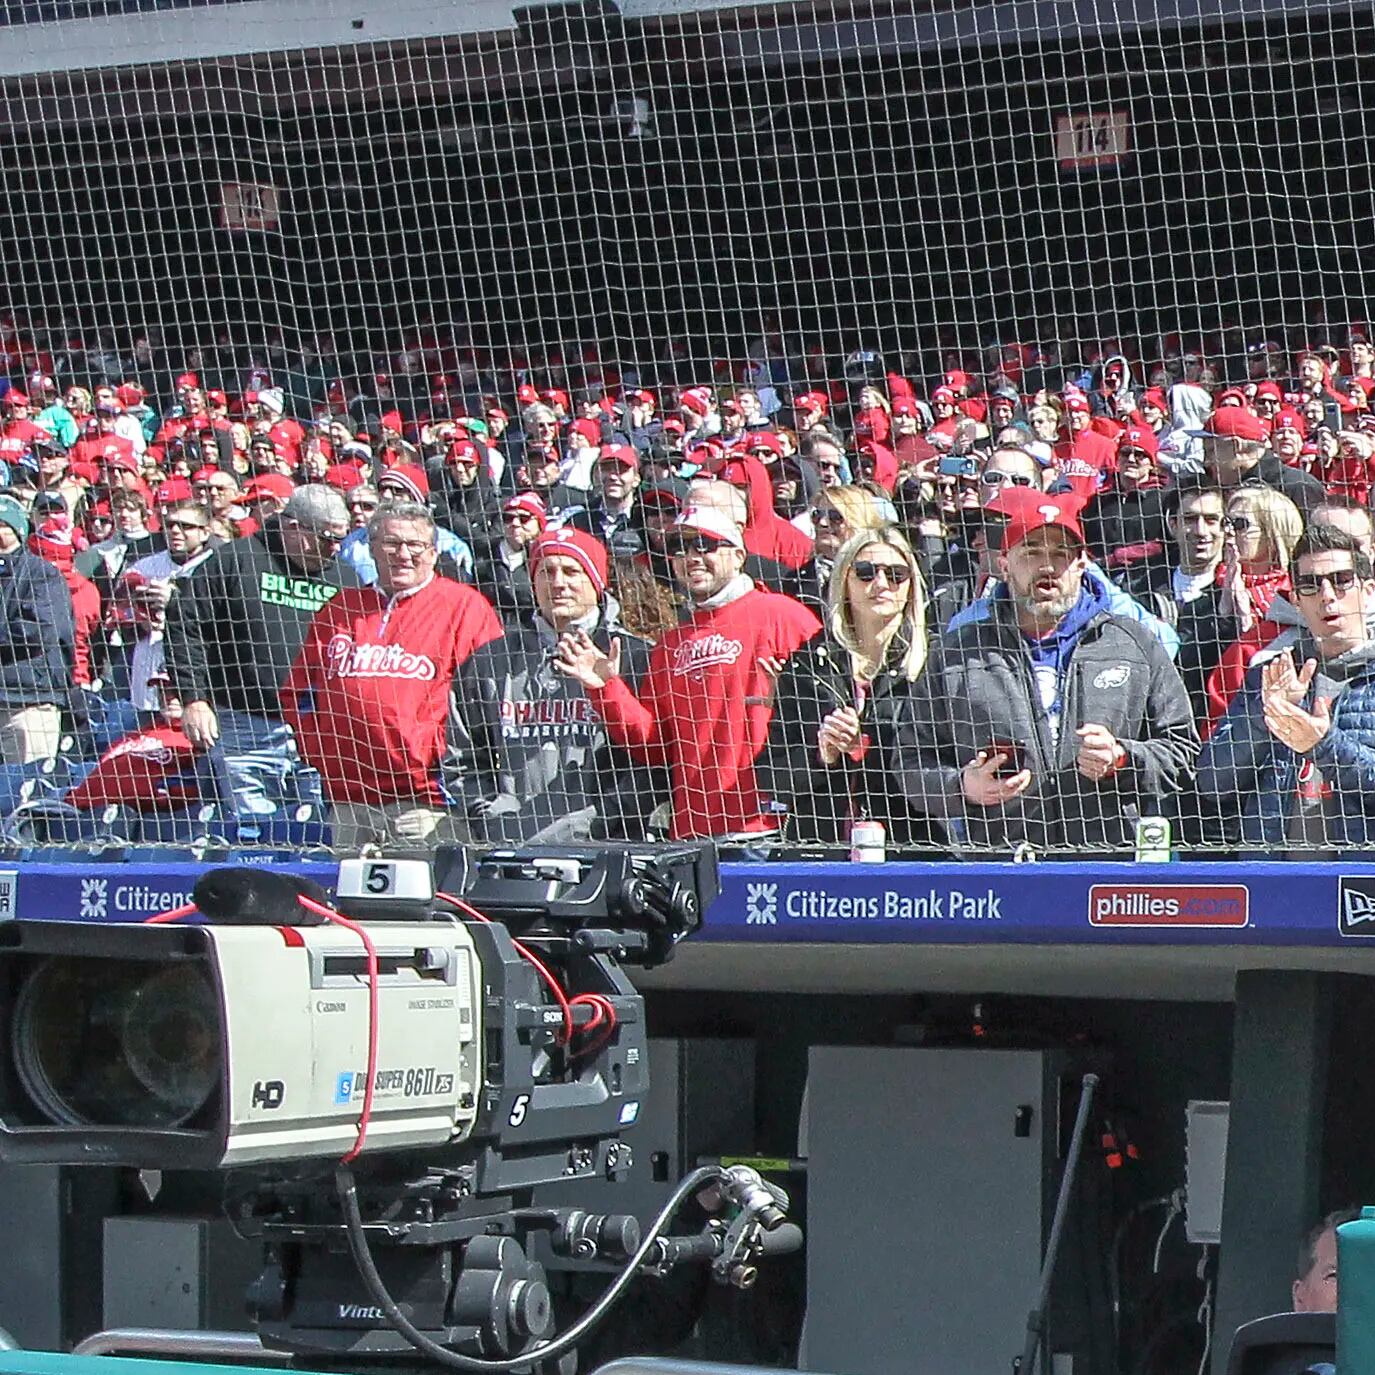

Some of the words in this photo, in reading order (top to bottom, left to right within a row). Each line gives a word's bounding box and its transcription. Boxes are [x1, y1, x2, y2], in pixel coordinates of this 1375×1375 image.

[1075, 118, 1109, 155] 114
[261, 572, 338, 602] BUCKS
[261, 593, 324, 613] LUMBE
[366, 863, 390, 893] 5
[113, 885, 196, 911] Citizens
[786, 890, 878, 917] Citizens
[884, 890, 944, 917] Bank
[949, 890, 1001, 918] Park
[316, 1000, 346, 1013] Canon
[543, 1010, 563, 1023] SON
[252, 1080, 285, 1110] HD
[508, 1093, 531, 1128] 5
